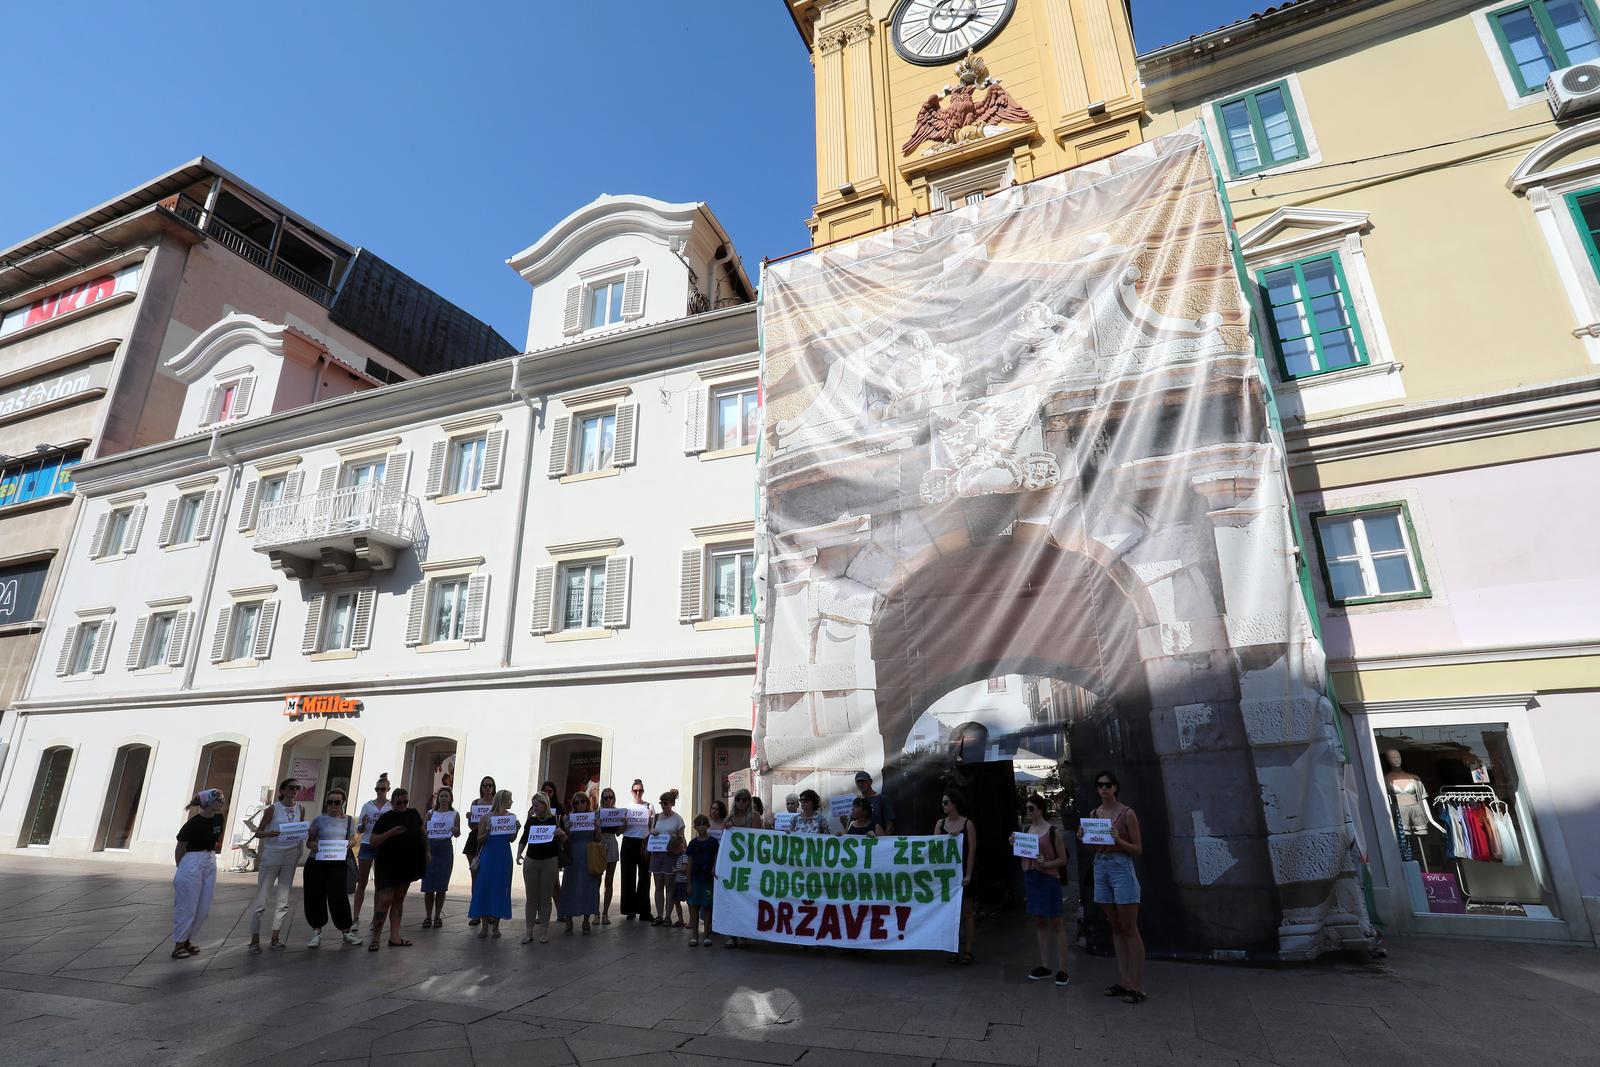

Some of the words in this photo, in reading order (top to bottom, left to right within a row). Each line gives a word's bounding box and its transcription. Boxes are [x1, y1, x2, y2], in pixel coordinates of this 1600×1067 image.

[47, 374, 91, 401] dom
[302, 695, 358, 713] Müller
[729, 831, 878, 869] SIGURNOST
[893, 836, 962, 865] ŽENA
[722, 867, 751, 892] JE
[759, 868, 956, 904] ODGOVORNOST
[756, 899, 912, 941] DRŽAVE!
